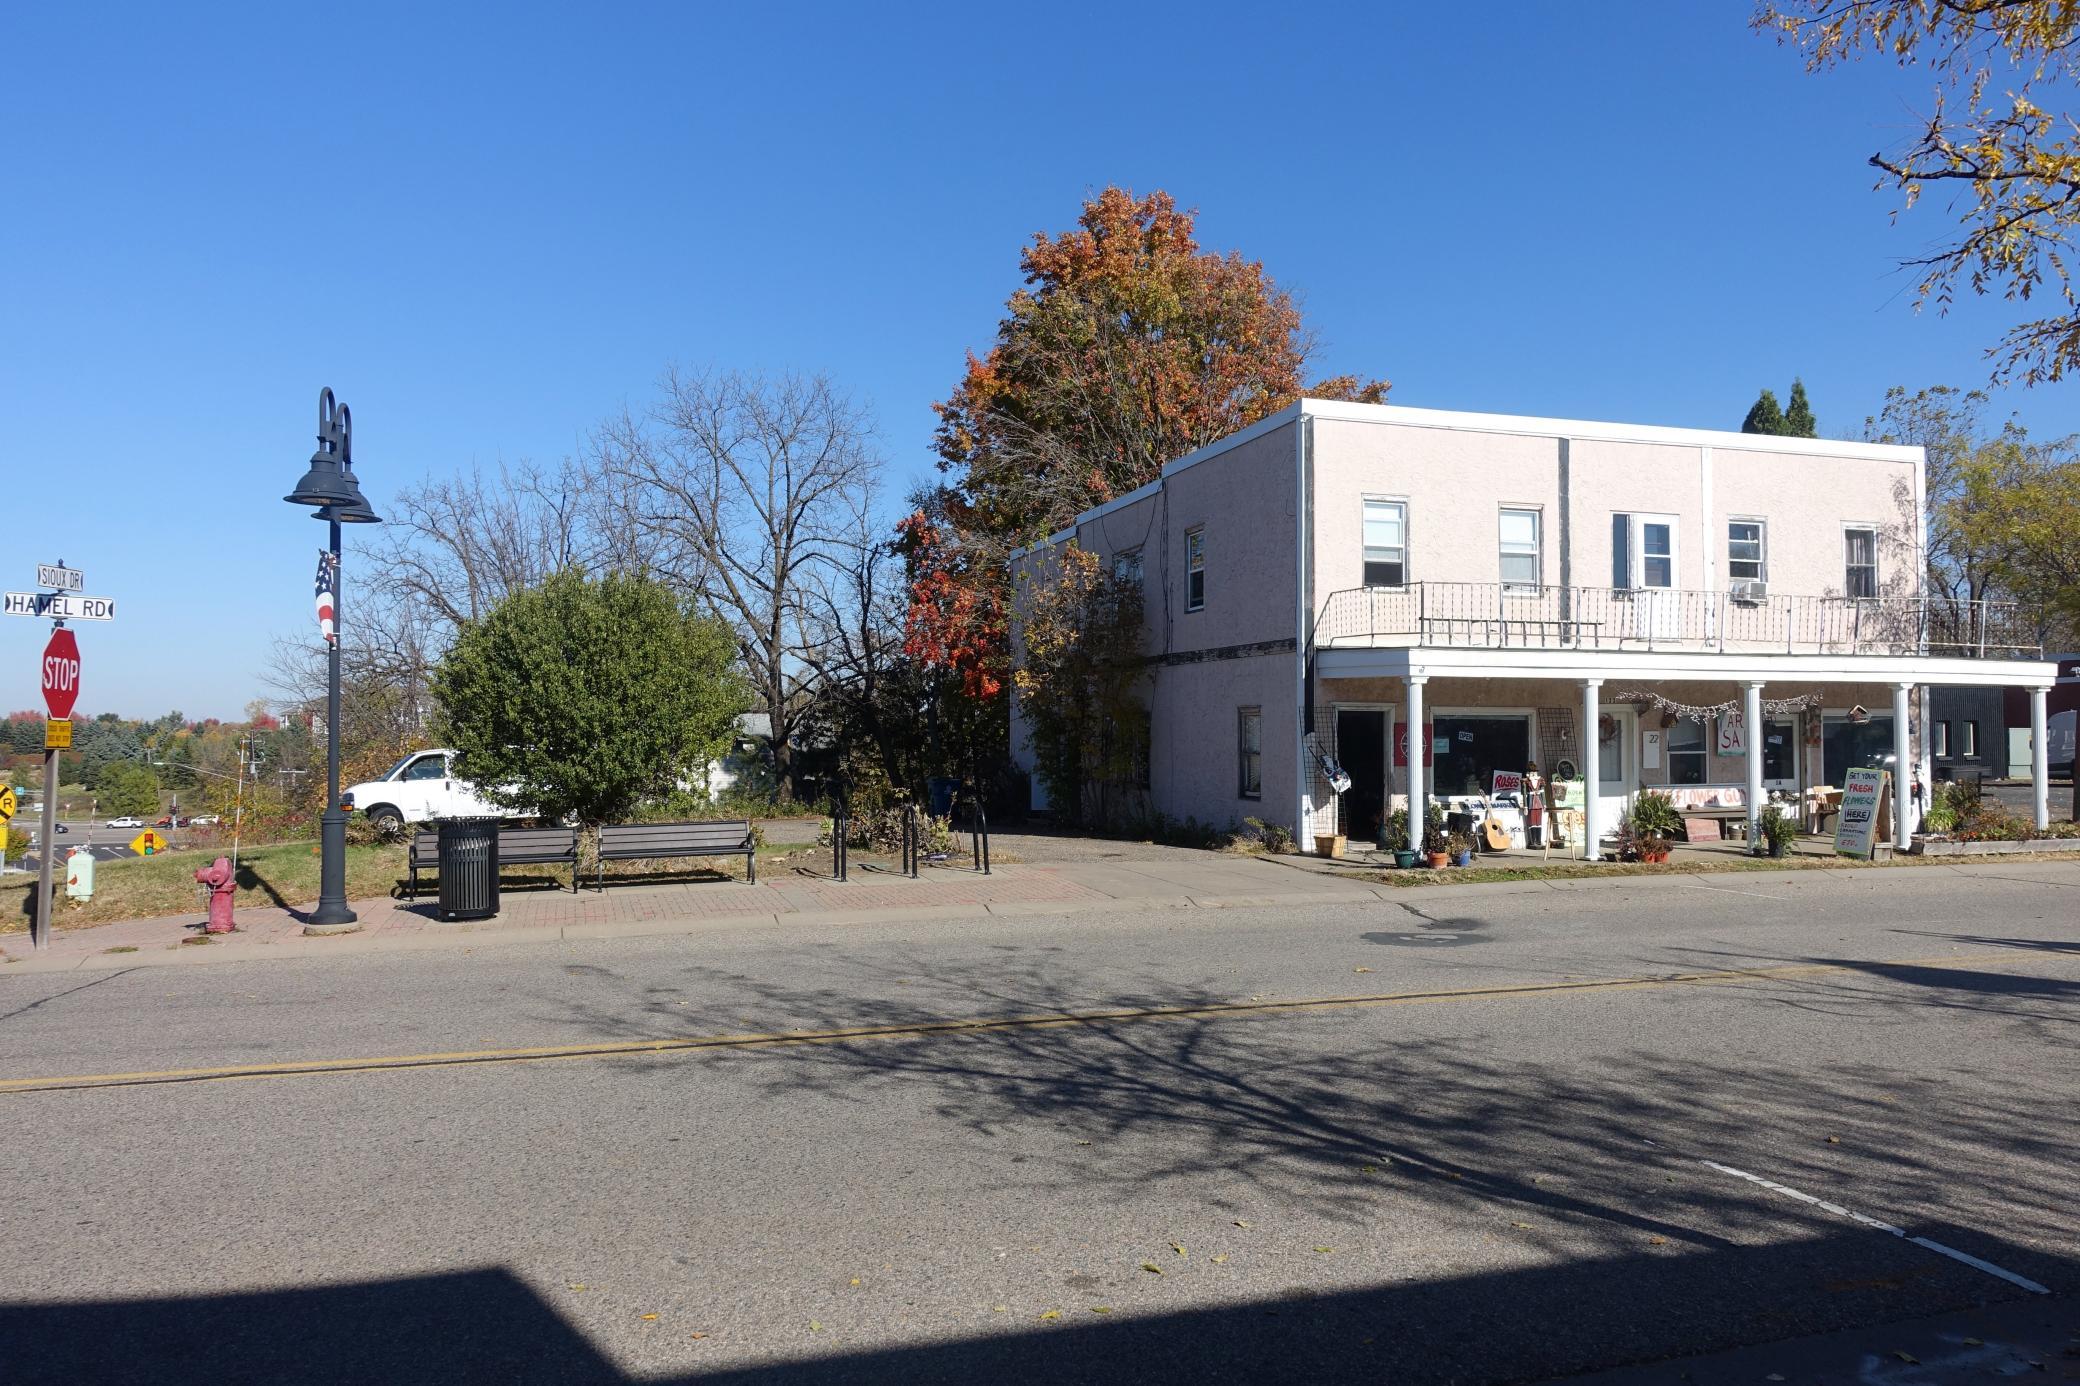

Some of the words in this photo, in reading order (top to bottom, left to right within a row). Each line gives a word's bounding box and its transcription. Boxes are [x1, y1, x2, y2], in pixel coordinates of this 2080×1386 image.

[42, 568, 66, 587] SIOUX
[70, 572, 80, 589] DR
[13, 596, 73, 615] HAMEL
[83, 600, 106, 617] RD
[44, 656, 78, 691] STOP
[1460, 732, 1473, 740] OPEN
[1649, 734, 1659, 744] 22
[1495, 775, 1520, 788] ROSES
[1849, 784, 1874, 793] FRESH
[3, 798, 13, 809] R
[1844, 796, 1876, 805] FLOWERS
[1847, 810, 1868, 818] HERE
